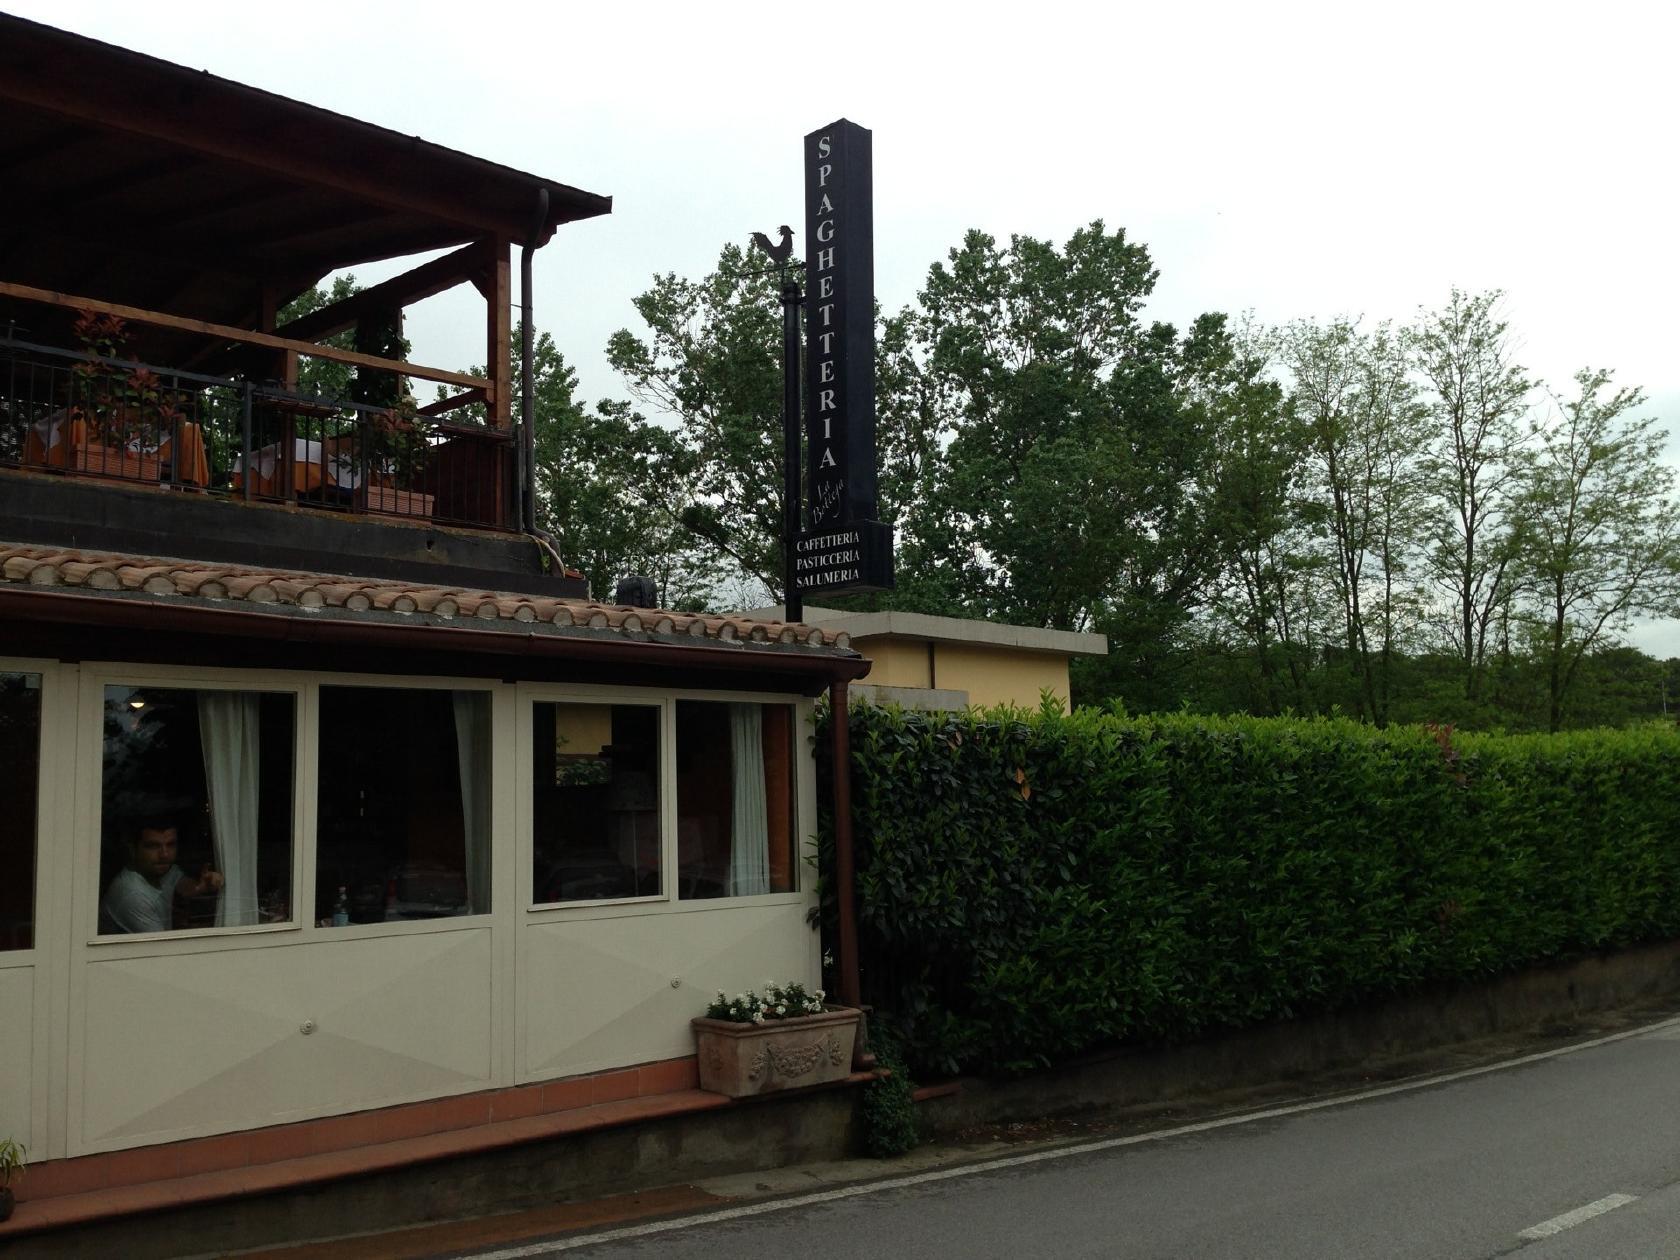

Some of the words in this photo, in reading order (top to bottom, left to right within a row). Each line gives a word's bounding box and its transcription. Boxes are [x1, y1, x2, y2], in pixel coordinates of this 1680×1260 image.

[816, 136, 837, 469] SPAGHETTERIA
[796, 531, 860, 552] CAFFETTERIA
[796, 549, 860, 571] PASTICCERIA
[796, 568, 859, 588] SALUMERIA
